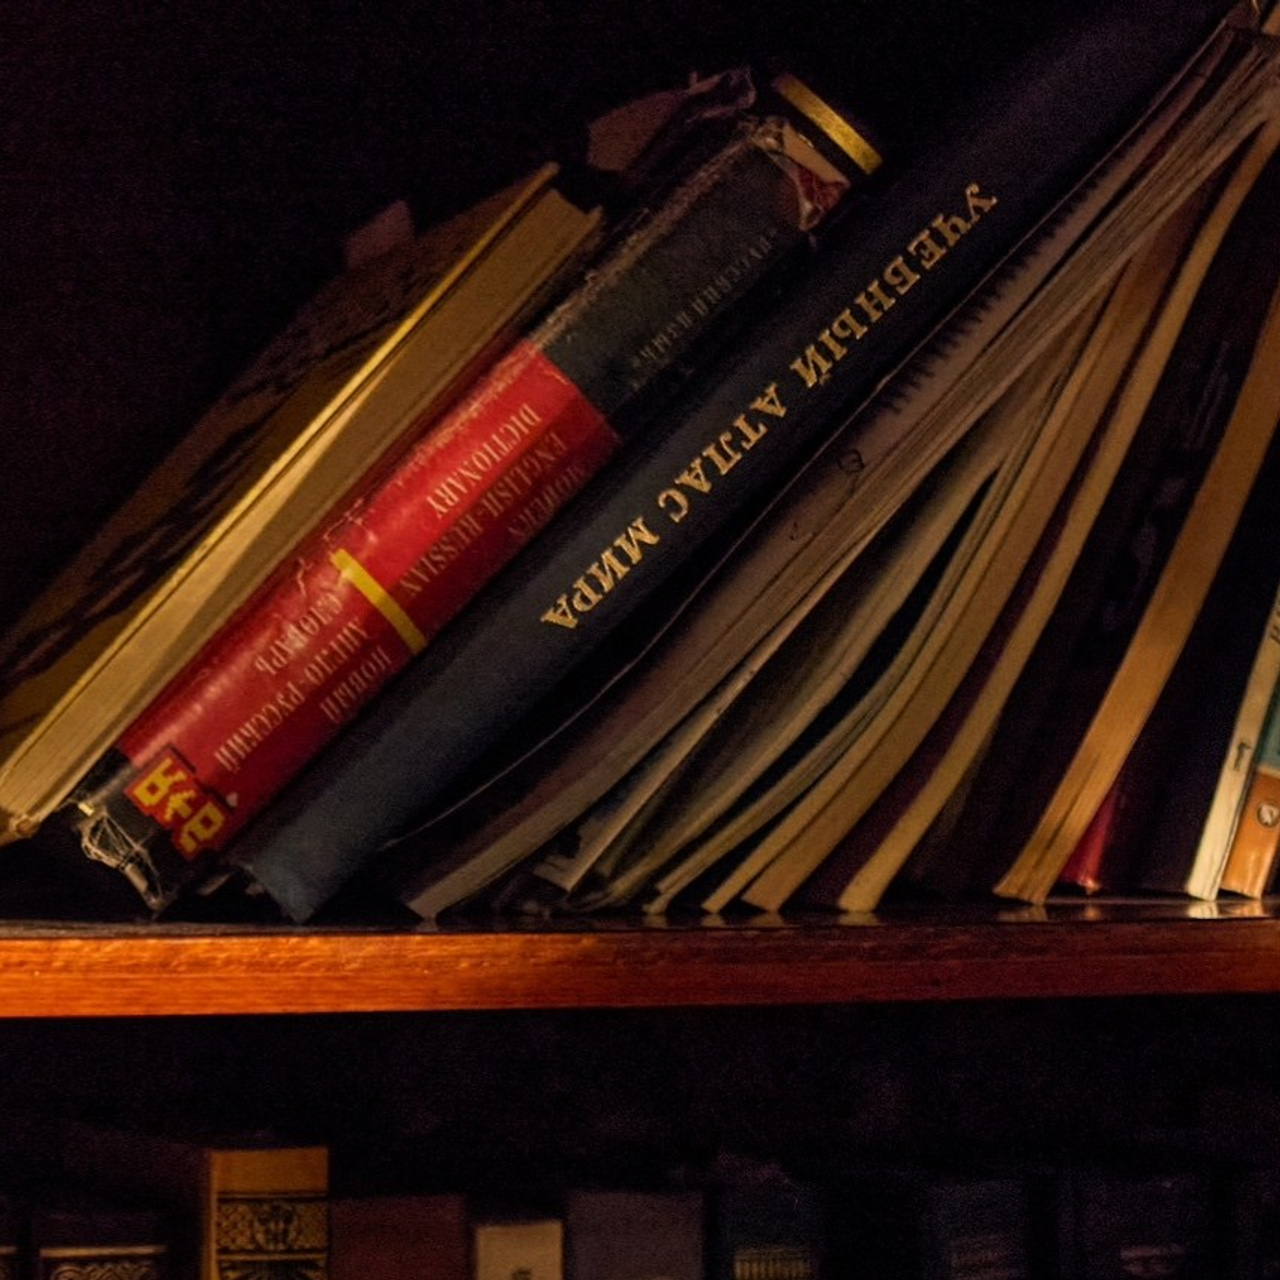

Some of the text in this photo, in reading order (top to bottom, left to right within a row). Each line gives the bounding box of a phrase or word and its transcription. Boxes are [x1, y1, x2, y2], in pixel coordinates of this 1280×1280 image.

[427, 402, 543, 520] DICTIONARY
[540, 180, 999, 632] УЧЕБНЫЙ АТЛАС МИРА
[398, 431, 568, 598] ENGLISH-RUSSIAN
[214, 618, 374, 774] АНГЛО-РУССКИЙ
[255, 582, 346, 680] СЛОВАРЬ
[320, 644, 392, 724] НОВЫЙ
